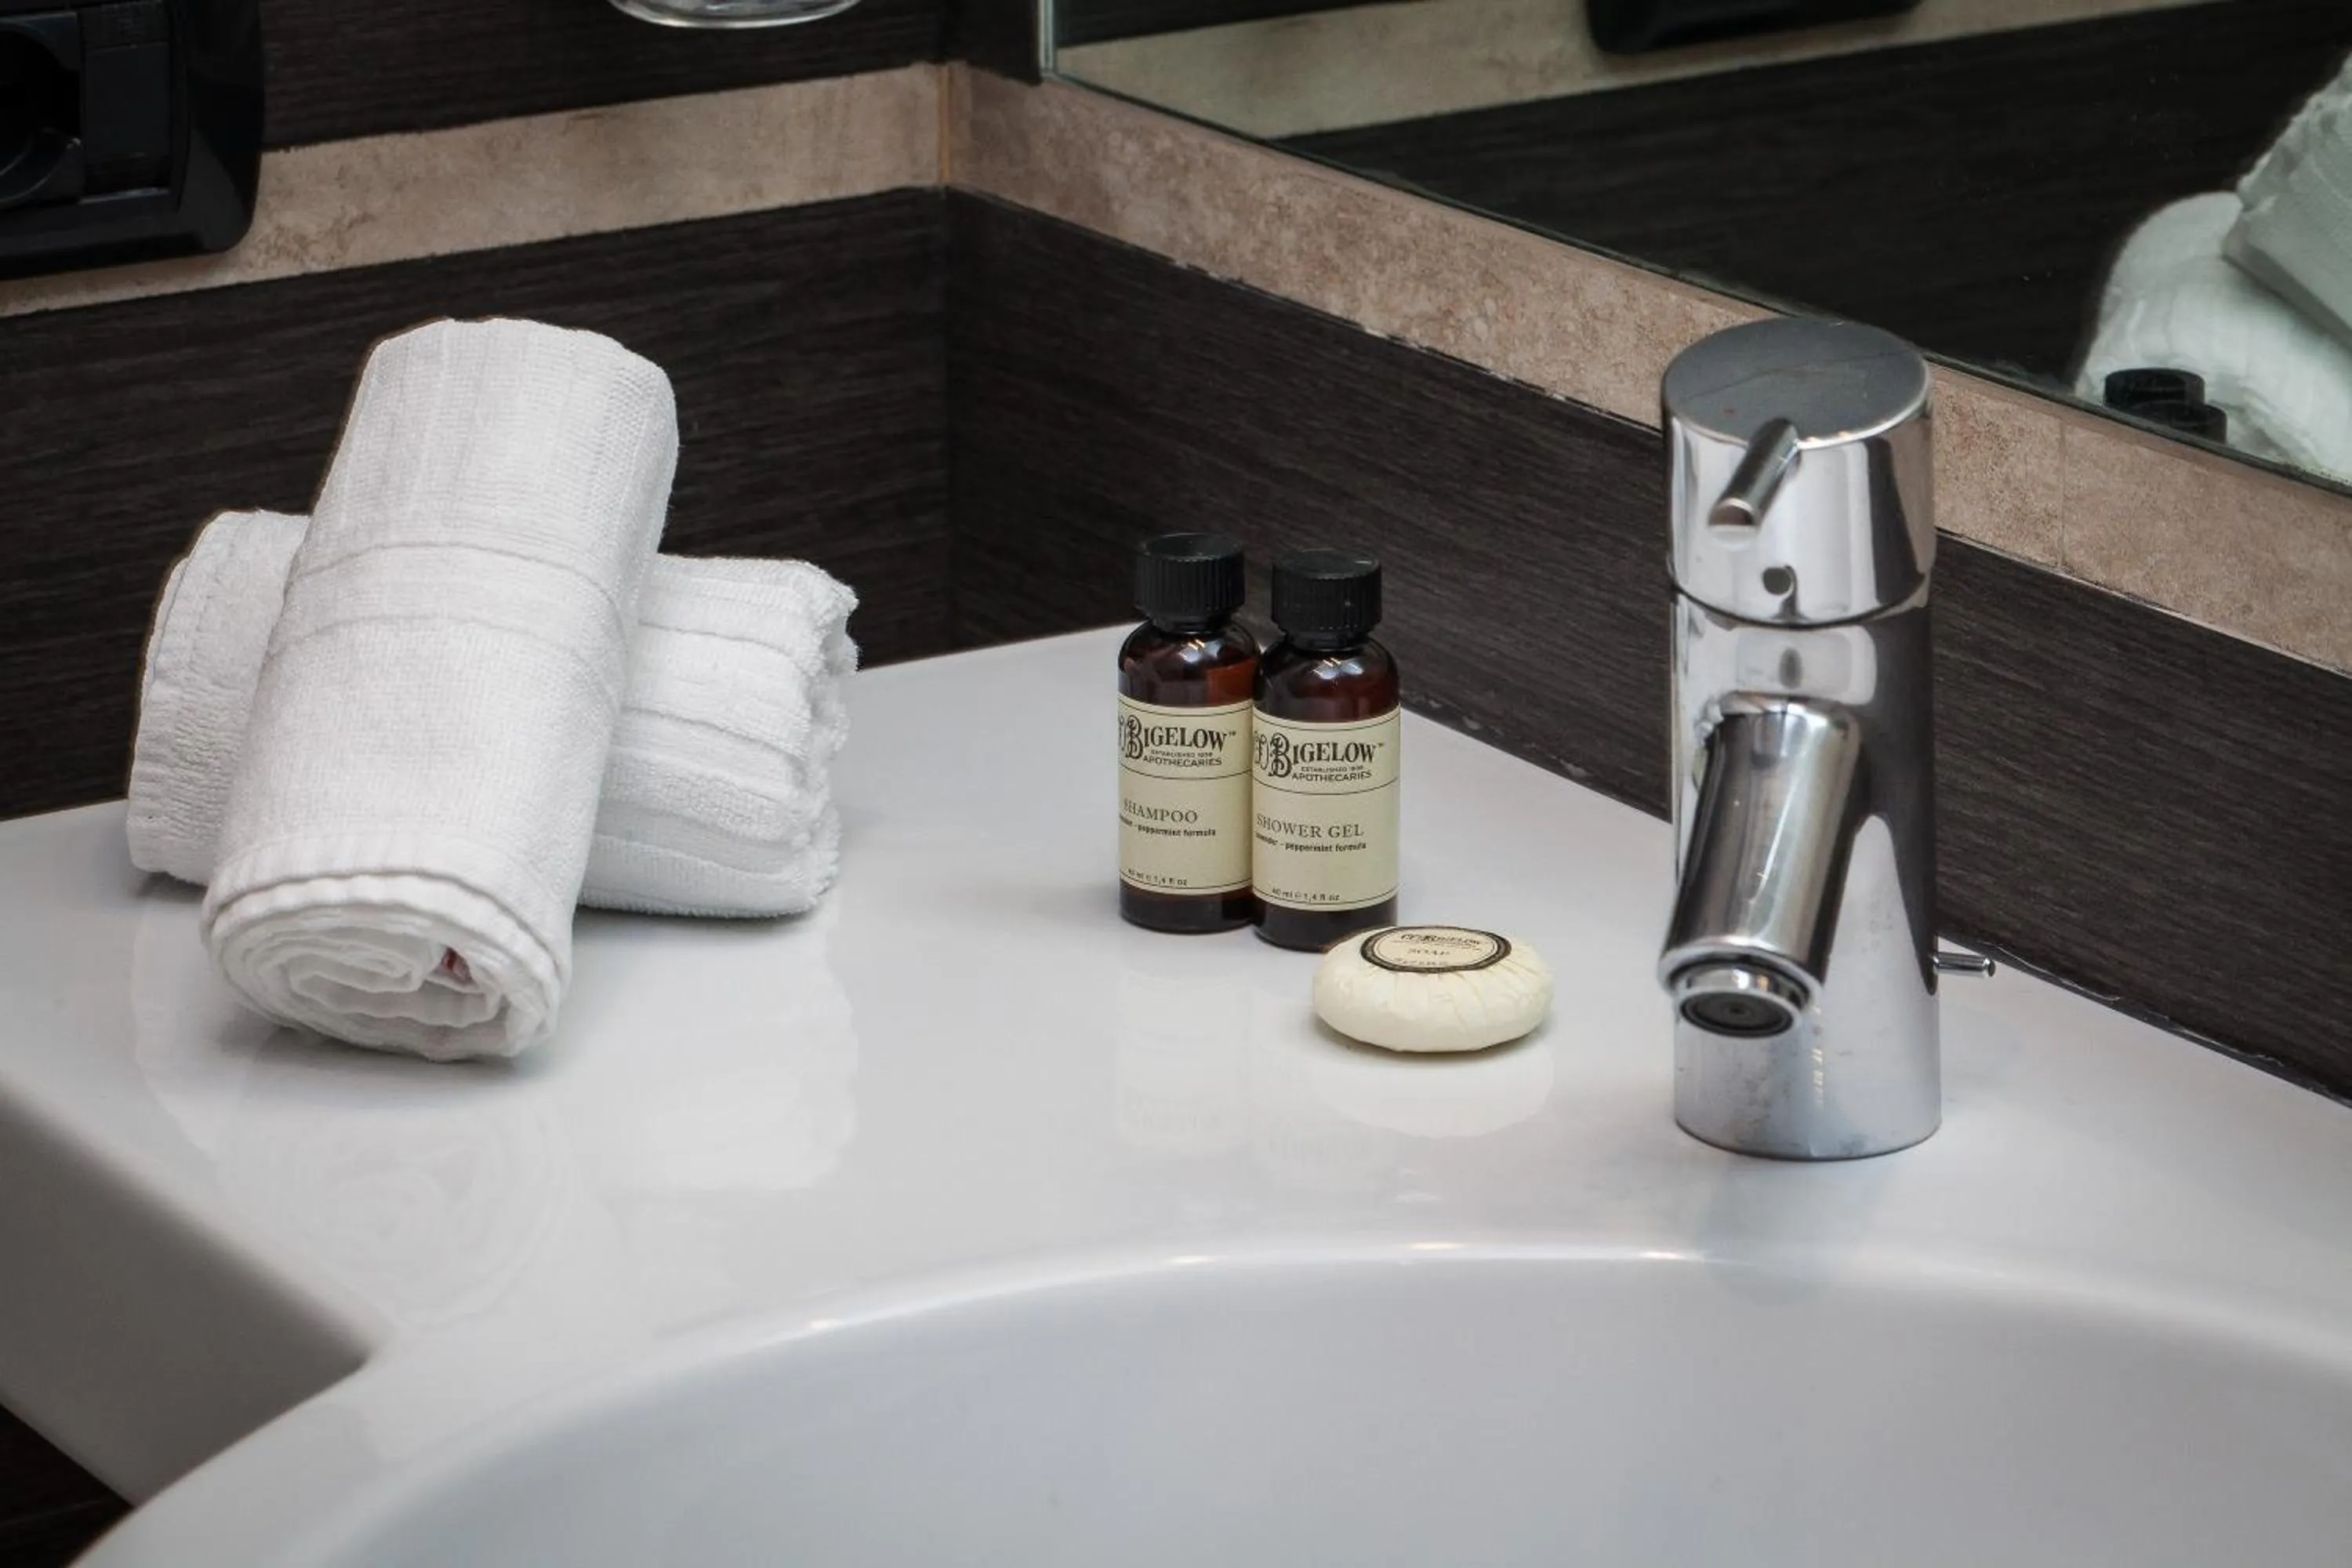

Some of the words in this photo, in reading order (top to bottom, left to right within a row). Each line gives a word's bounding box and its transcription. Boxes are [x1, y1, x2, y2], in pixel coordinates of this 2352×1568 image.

[1142, 755, 1223, 768] APOTHECARIES
[1291, 770, 1373, 782] APOTHECARIES
[1256, 813, 1322, 838] SHOWER
[1327, 823, 1365, 839] GEL
[1183, 828, 1216, 837] formula
[1285, 843, 1333, 852] peppermint
[1335, 841, 1367, 852] formula
